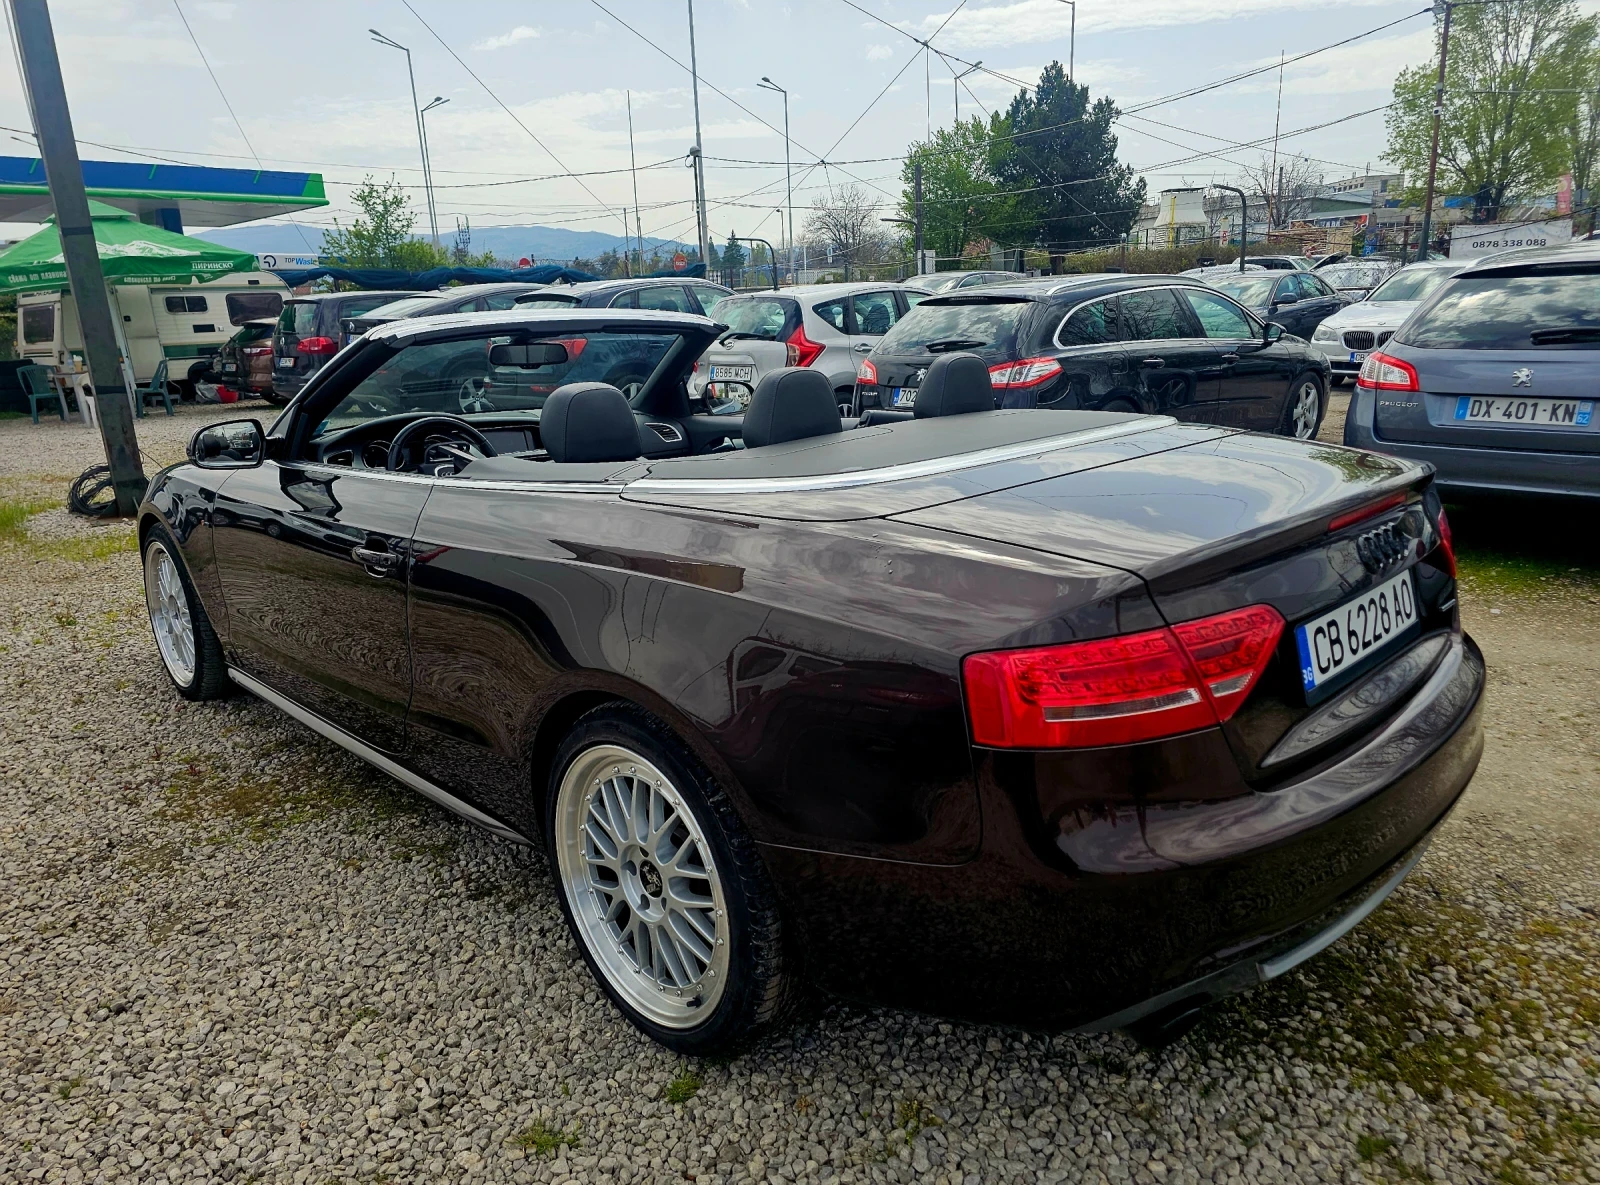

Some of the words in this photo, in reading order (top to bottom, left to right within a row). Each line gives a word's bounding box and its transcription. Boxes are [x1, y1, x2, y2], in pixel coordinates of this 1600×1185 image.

[1472, 240, 1499, 249] 0878
[1502, 239, 1523, 248] 338
[1526, 238, 1547, 247] 088
[715, 367, 733, 377] 8585
[1379, 400, 1419, 408] PEUGEOT
[1576, 413, 1590, 424] 62
[1313, 618, 1345, 676] CB
[1347, 591, 1391, 656] 6228
[1392, 578, 1413, 629] AO
